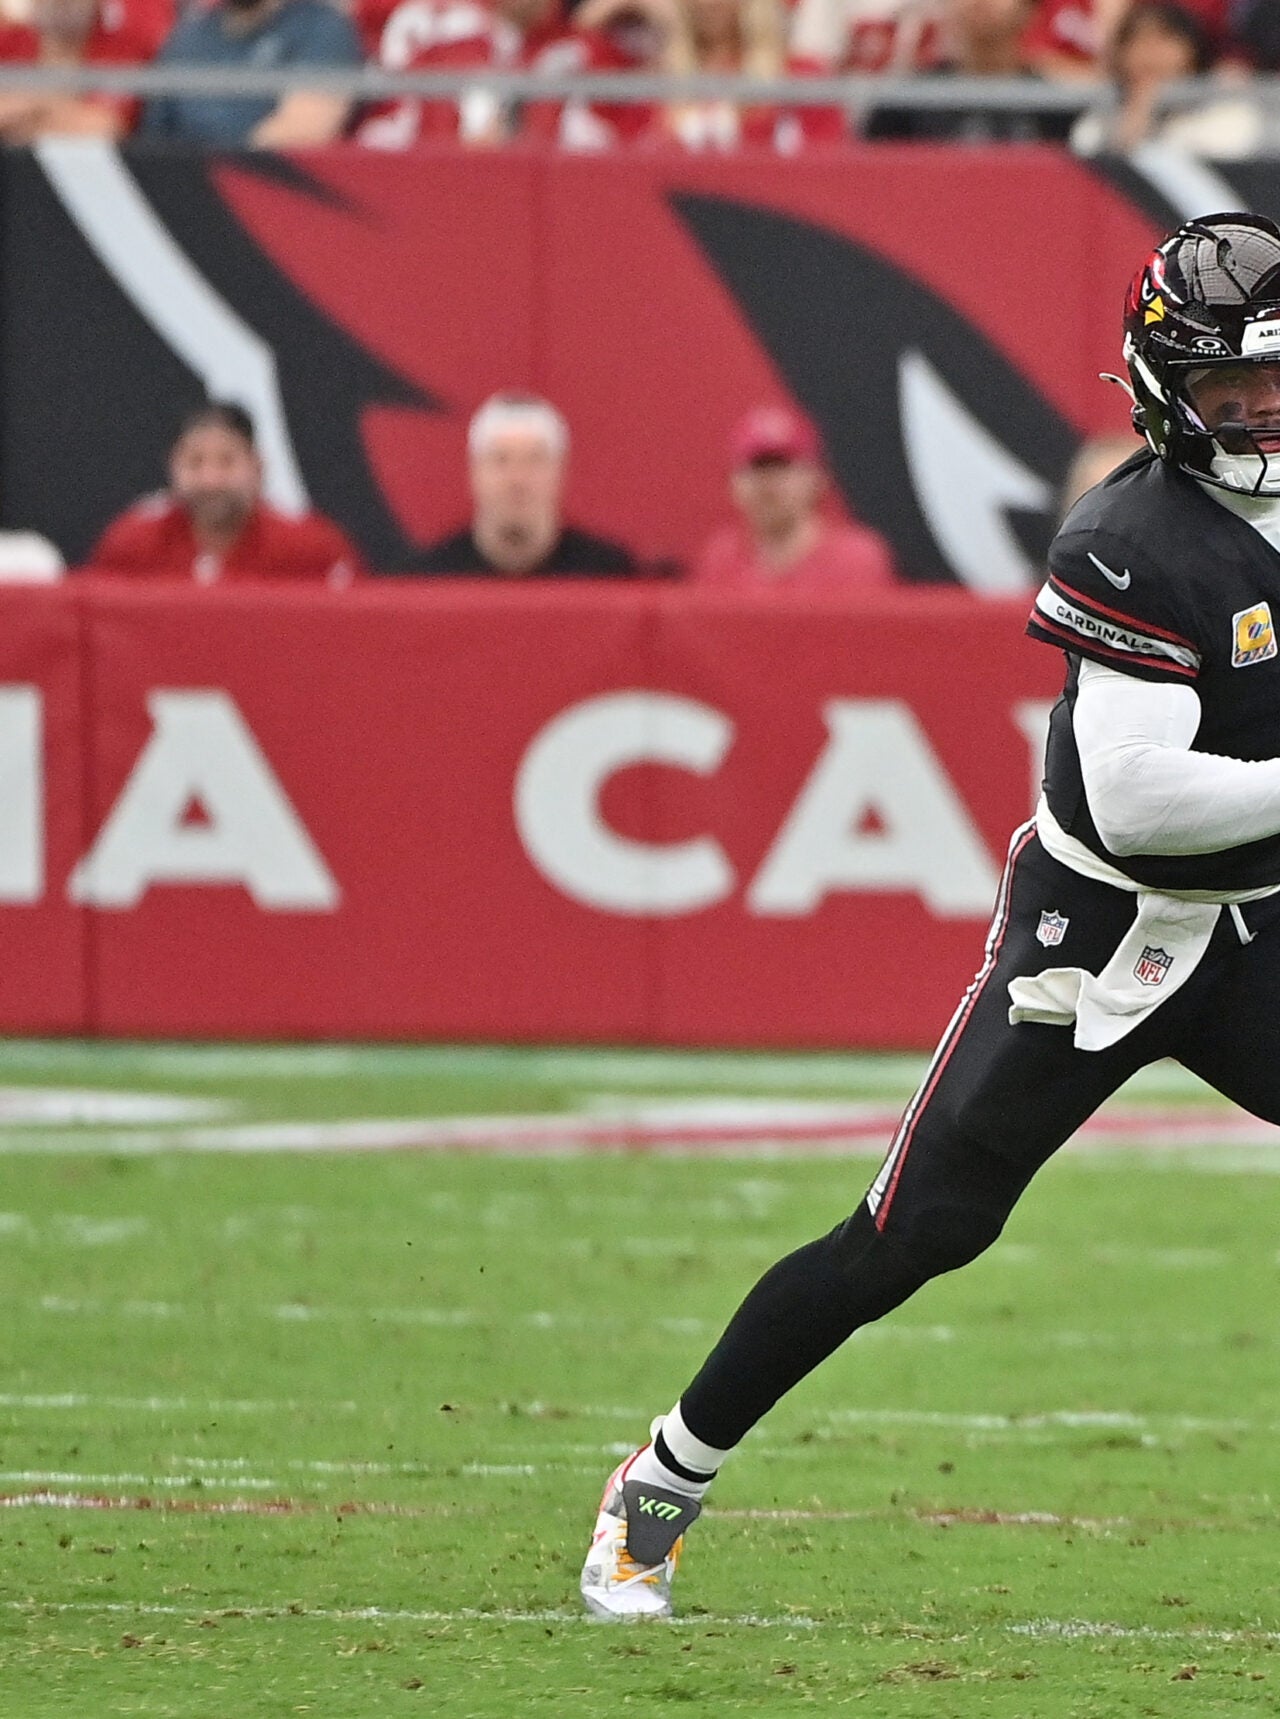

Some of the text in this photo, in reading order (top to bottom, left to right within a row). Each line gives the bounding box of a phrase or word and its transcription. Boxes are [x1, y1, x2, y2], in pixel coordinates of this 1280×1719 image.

[1237, 608, 1273, 652] C
[1041, 925, 1061, 941] NFL
[1137, 960, 1162, 983] NFL
